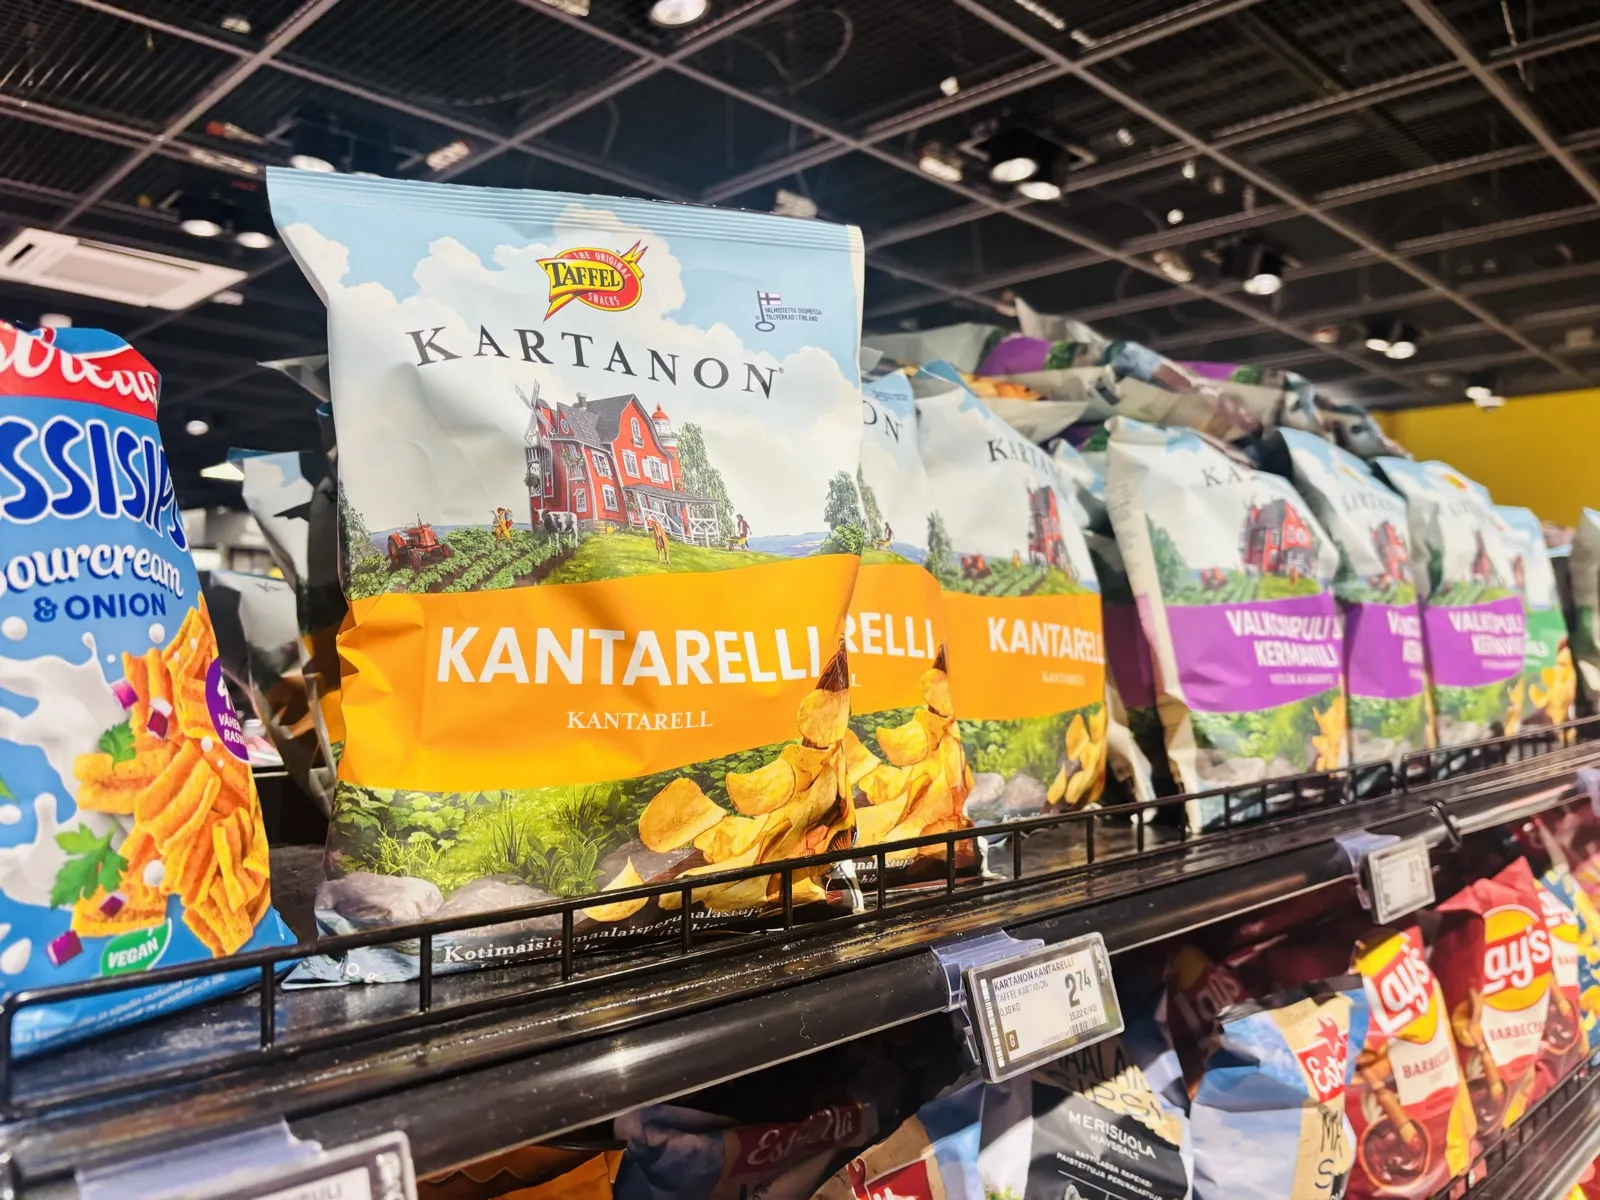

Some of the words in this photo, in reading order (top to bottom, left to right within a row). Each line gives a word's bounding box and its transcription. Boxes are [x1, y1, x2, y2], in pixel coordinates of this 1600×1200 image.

[544, 262, 620, 288] TAFFEL
[573, 251, 591, 260] THE
[595, 252, 632, 279] ORIGINAL
[588, 292, 620, 306] SNACKS
[405, 324, 778, 399] KARTANON
[0, 545, 183, 597] ourcream
[34, 597, 58, 622] &
[65, 593, 166, 620] ONION
[437, 625, 820, 687] KANTARELLI
[567, 710, 713, 731] KANTARELL
[108, 939, 159, 969] VEGAN
[443, 937, 563, 963] Kotimaisia
[993, 970, 1034, 992] KARTANON
[1034, 957, 1075, 981] KANTARELLI
[996, 990, 1018, 1004] TAFFEL
[1018, 980, 1049, 999] KARTANON
[1068, 1111, 1157, 1160] MERISUOLA
[1056, 1151, 1106, 1179] PAISTETTUJA
